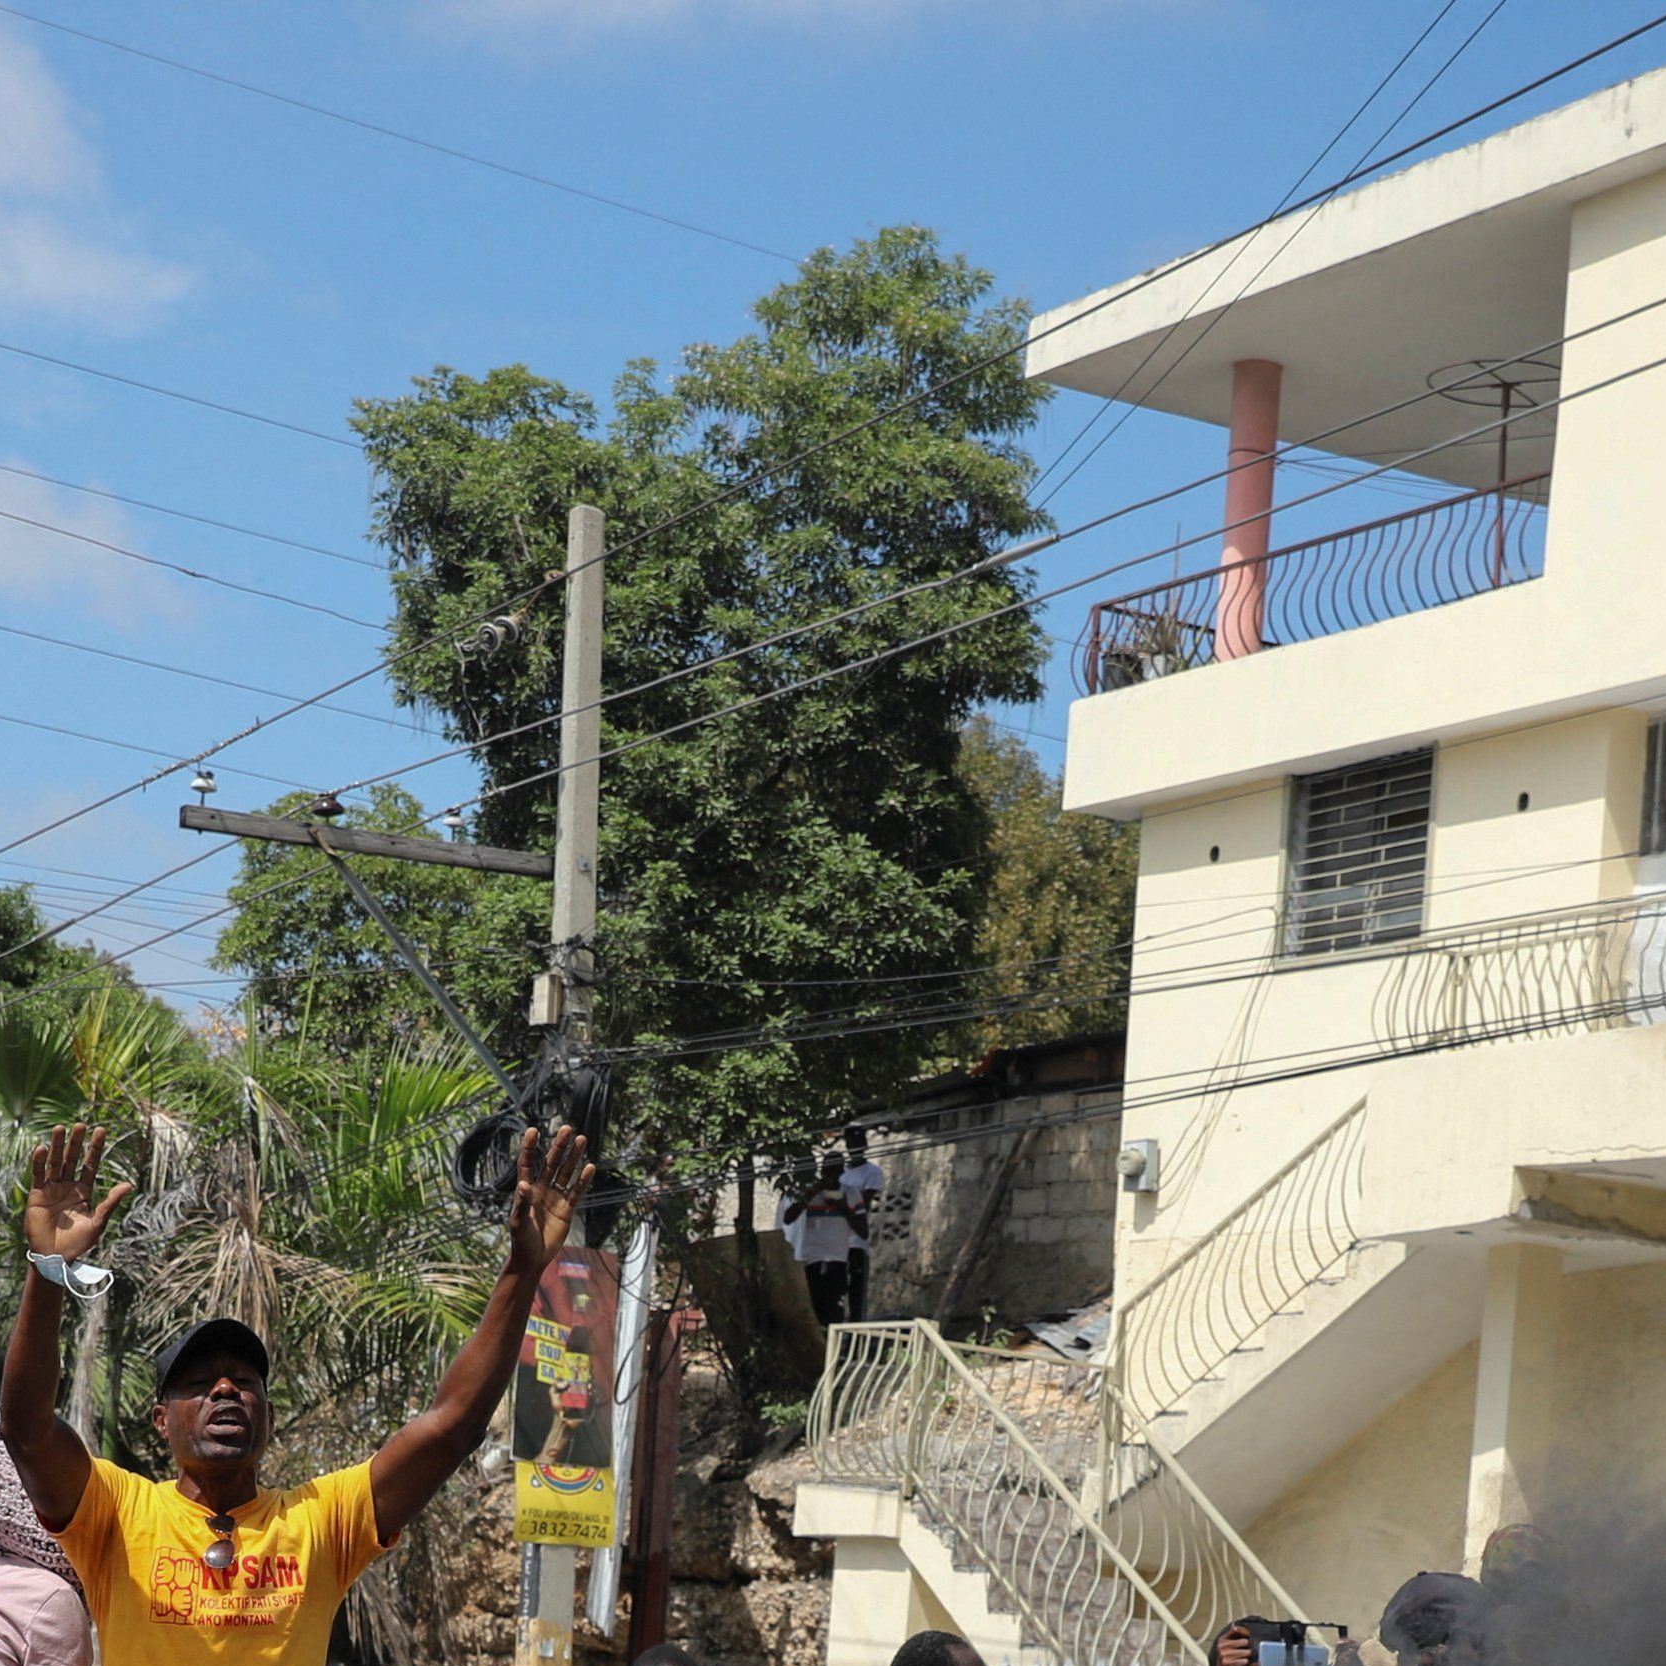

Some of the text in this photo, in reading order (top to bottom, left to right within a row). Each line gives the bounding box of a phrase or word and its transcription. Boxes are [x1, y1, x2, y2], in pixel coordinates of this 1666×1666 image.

[200, 1597, 250, 1610] KOLEKTIF
[198, 1613, 275, 1627] AKO MONTANA
